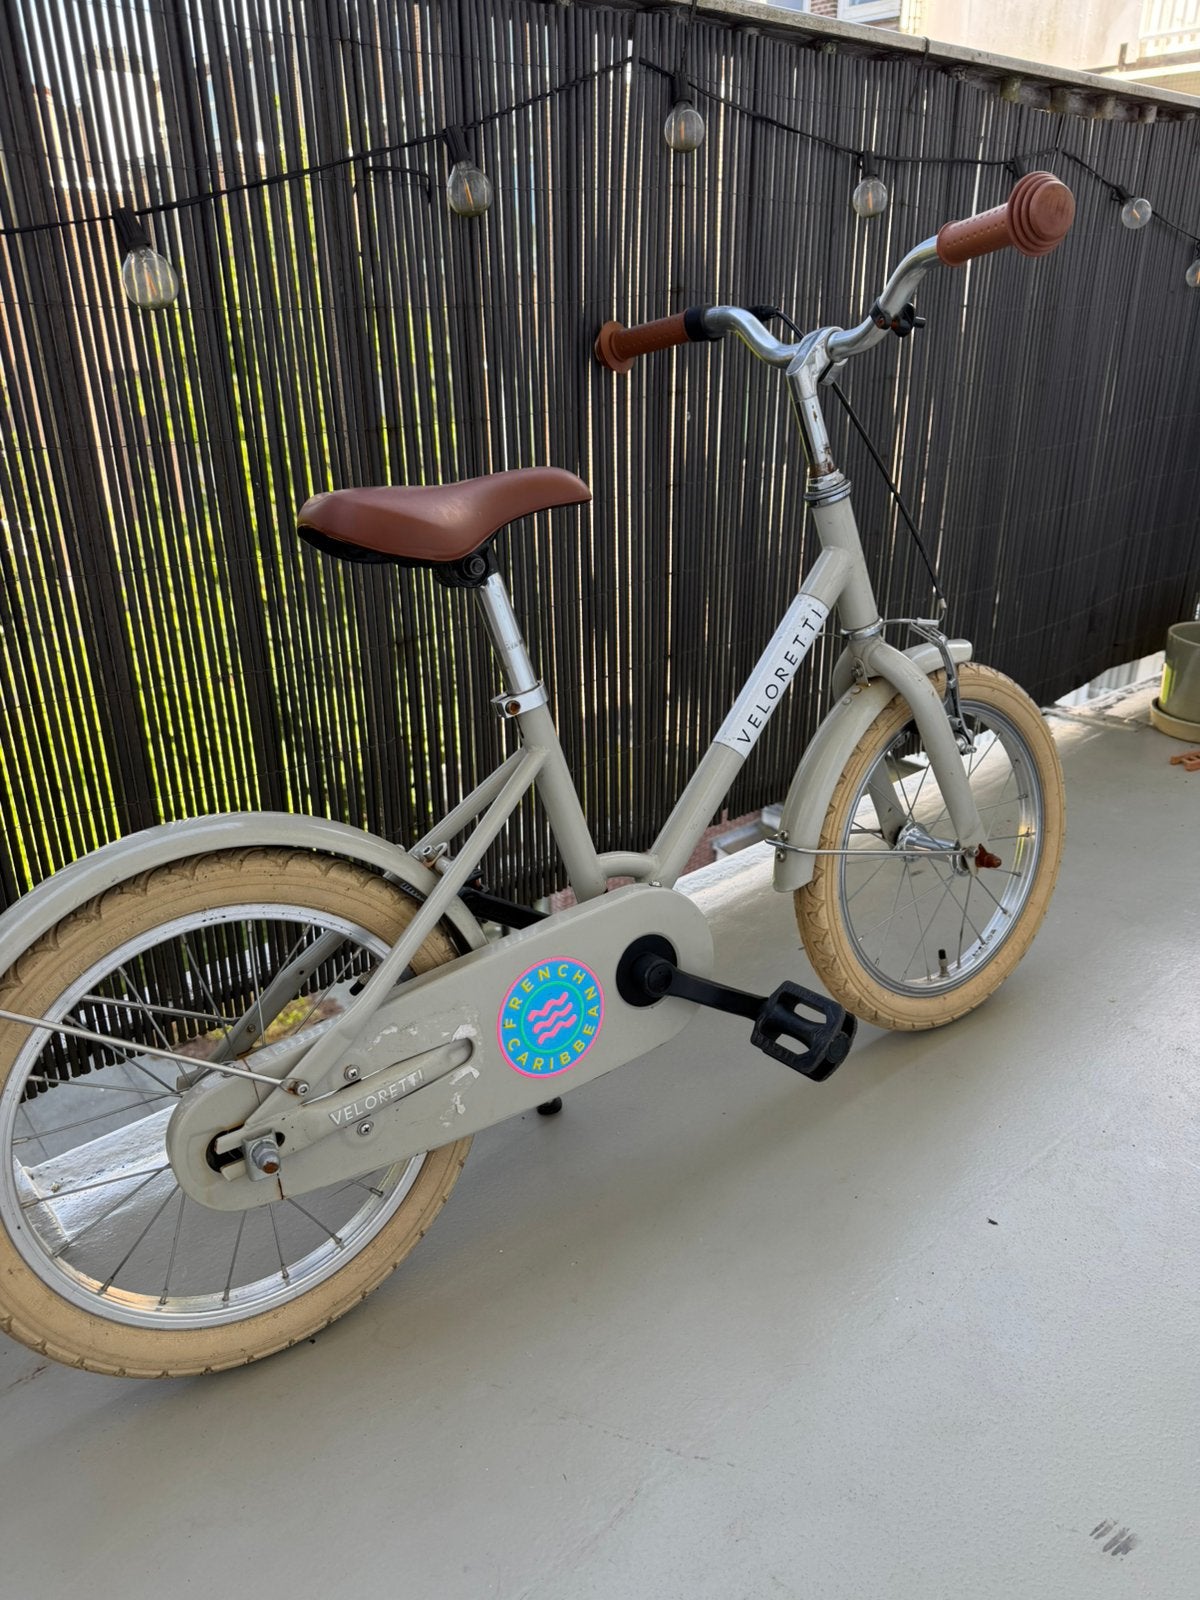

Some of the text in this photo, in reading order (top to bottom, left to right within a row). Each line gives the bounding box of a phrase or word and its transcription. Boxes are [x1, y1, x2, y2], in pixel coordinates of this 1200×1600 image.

[737, 608, 823, 744] VELORETTI
[503, 964, 586, 1029] FRENCH
[507, 986, 599, 1071] CARIBBEAN
[330, 1069, 423, 1125] VELORETTI
